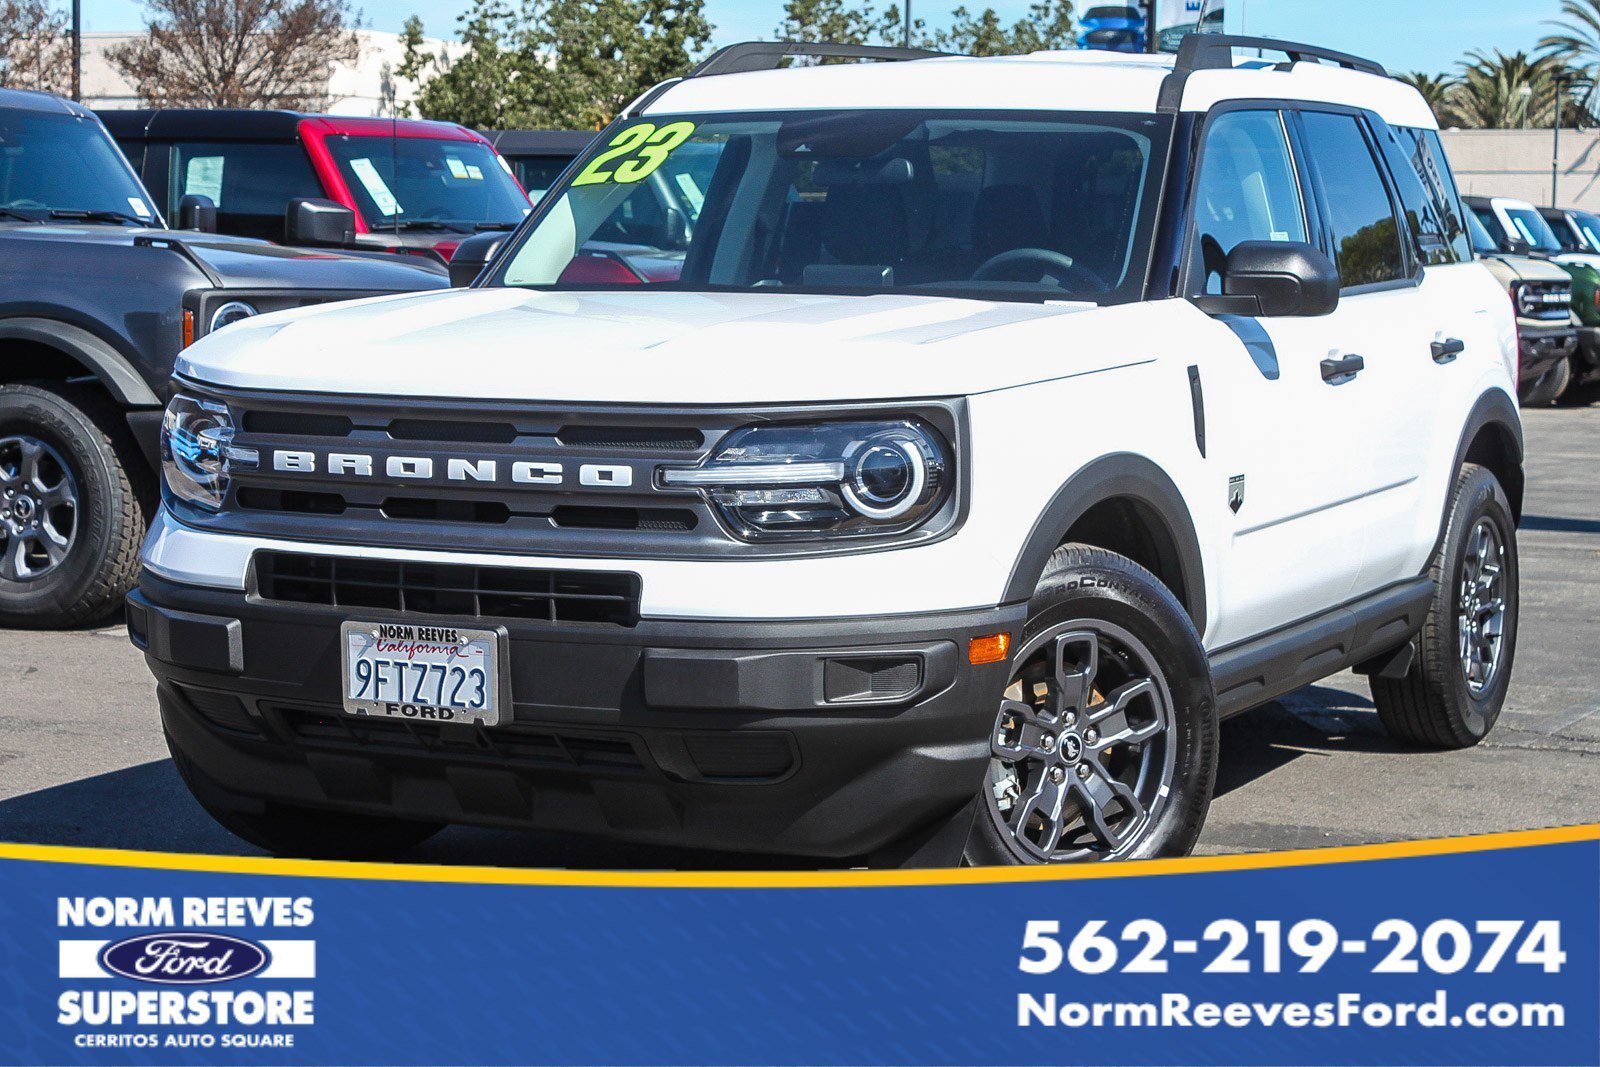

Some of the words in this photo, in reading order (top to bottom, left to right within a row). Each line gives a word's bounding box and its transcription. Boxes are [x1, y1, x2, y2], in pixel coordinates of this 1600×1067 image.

[571, 121, 695, 186] 23
[273, 449, 633, 487] BRONCO
[377, 638, 469, 660] California
[379, 625, 414, 640] NORM
[418, 628, 458, 643] REEVES
[356, 658, 486, 708] 9FTZ723
[386, 703, 454, 720] FORD
